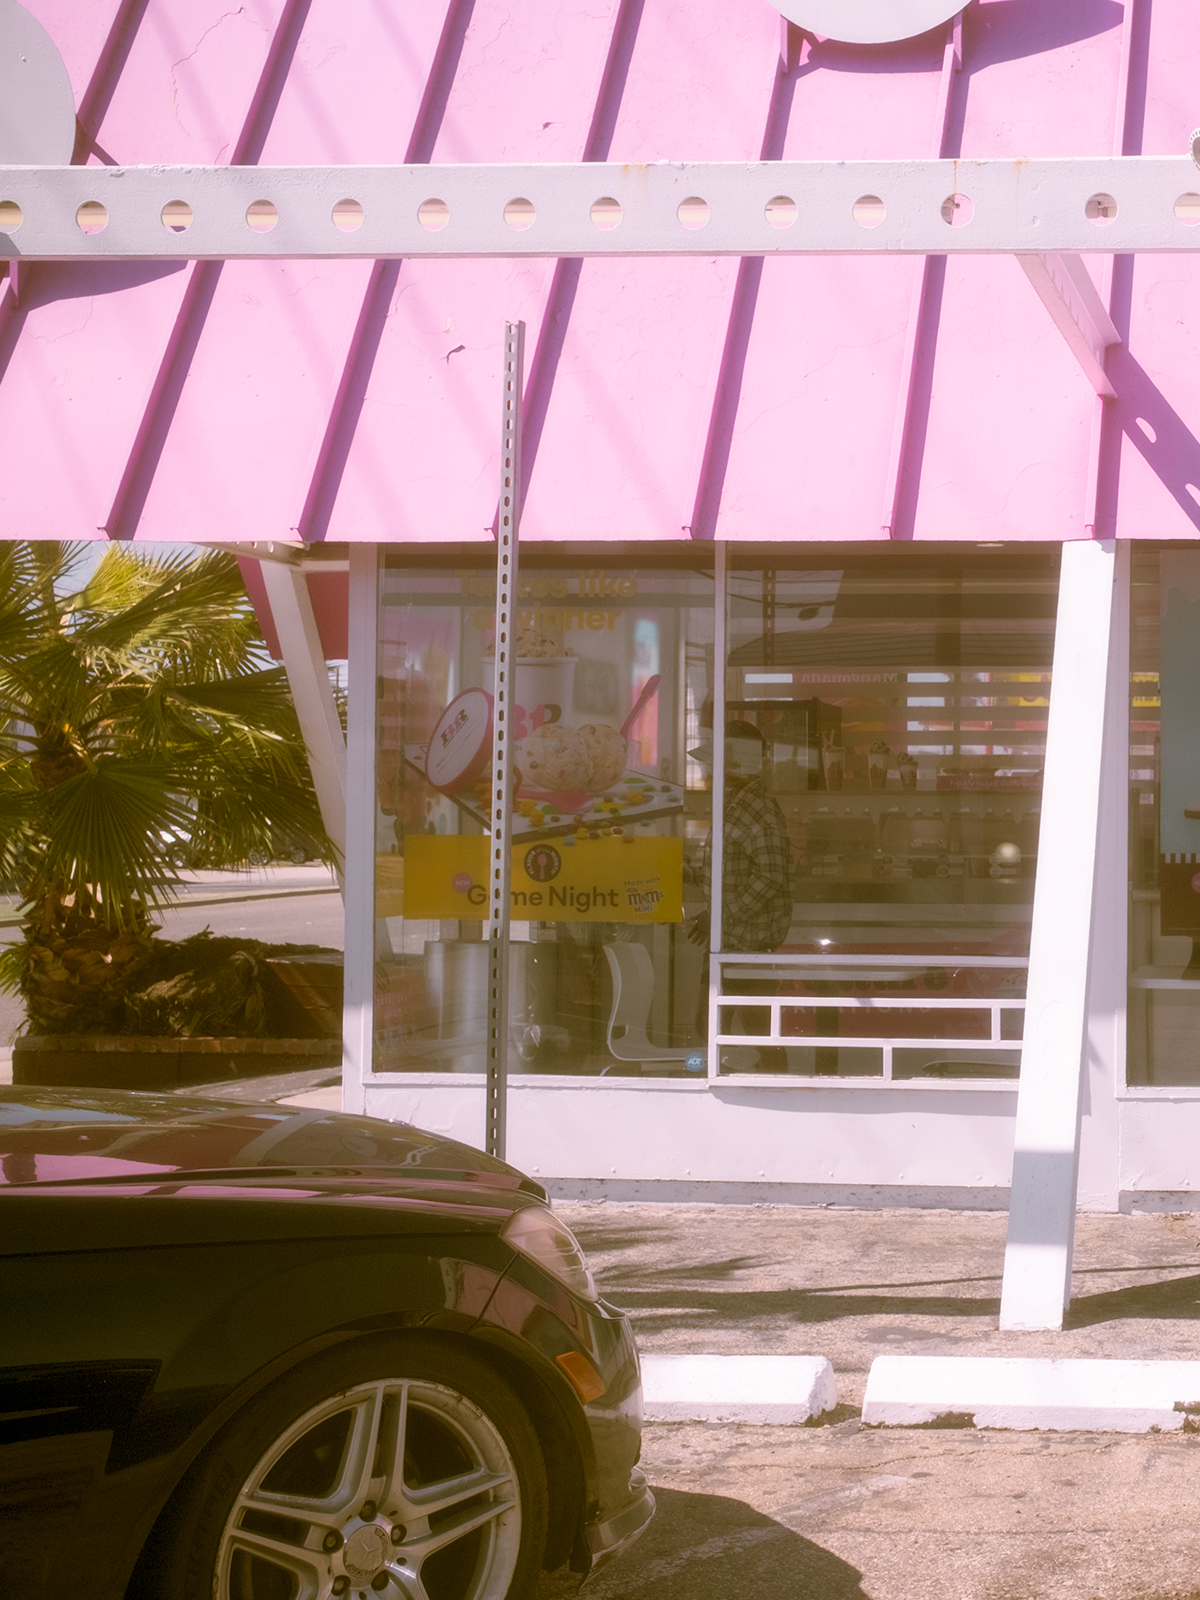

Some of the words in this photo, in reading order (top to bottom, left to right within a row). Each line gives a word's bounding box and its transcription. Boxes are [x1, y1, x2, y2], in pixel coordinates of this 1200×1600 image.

[578, 568, 639, 598] like
[527, 850, 536, 875] FLAVOR
[550, 851, 559, 875] MONTH
[645, 876, 662, 884] with
[467, 884, 543, 906] Gme
[549, 885, 619, 913] Night
[687, 1057, 702, 1066] ADT
